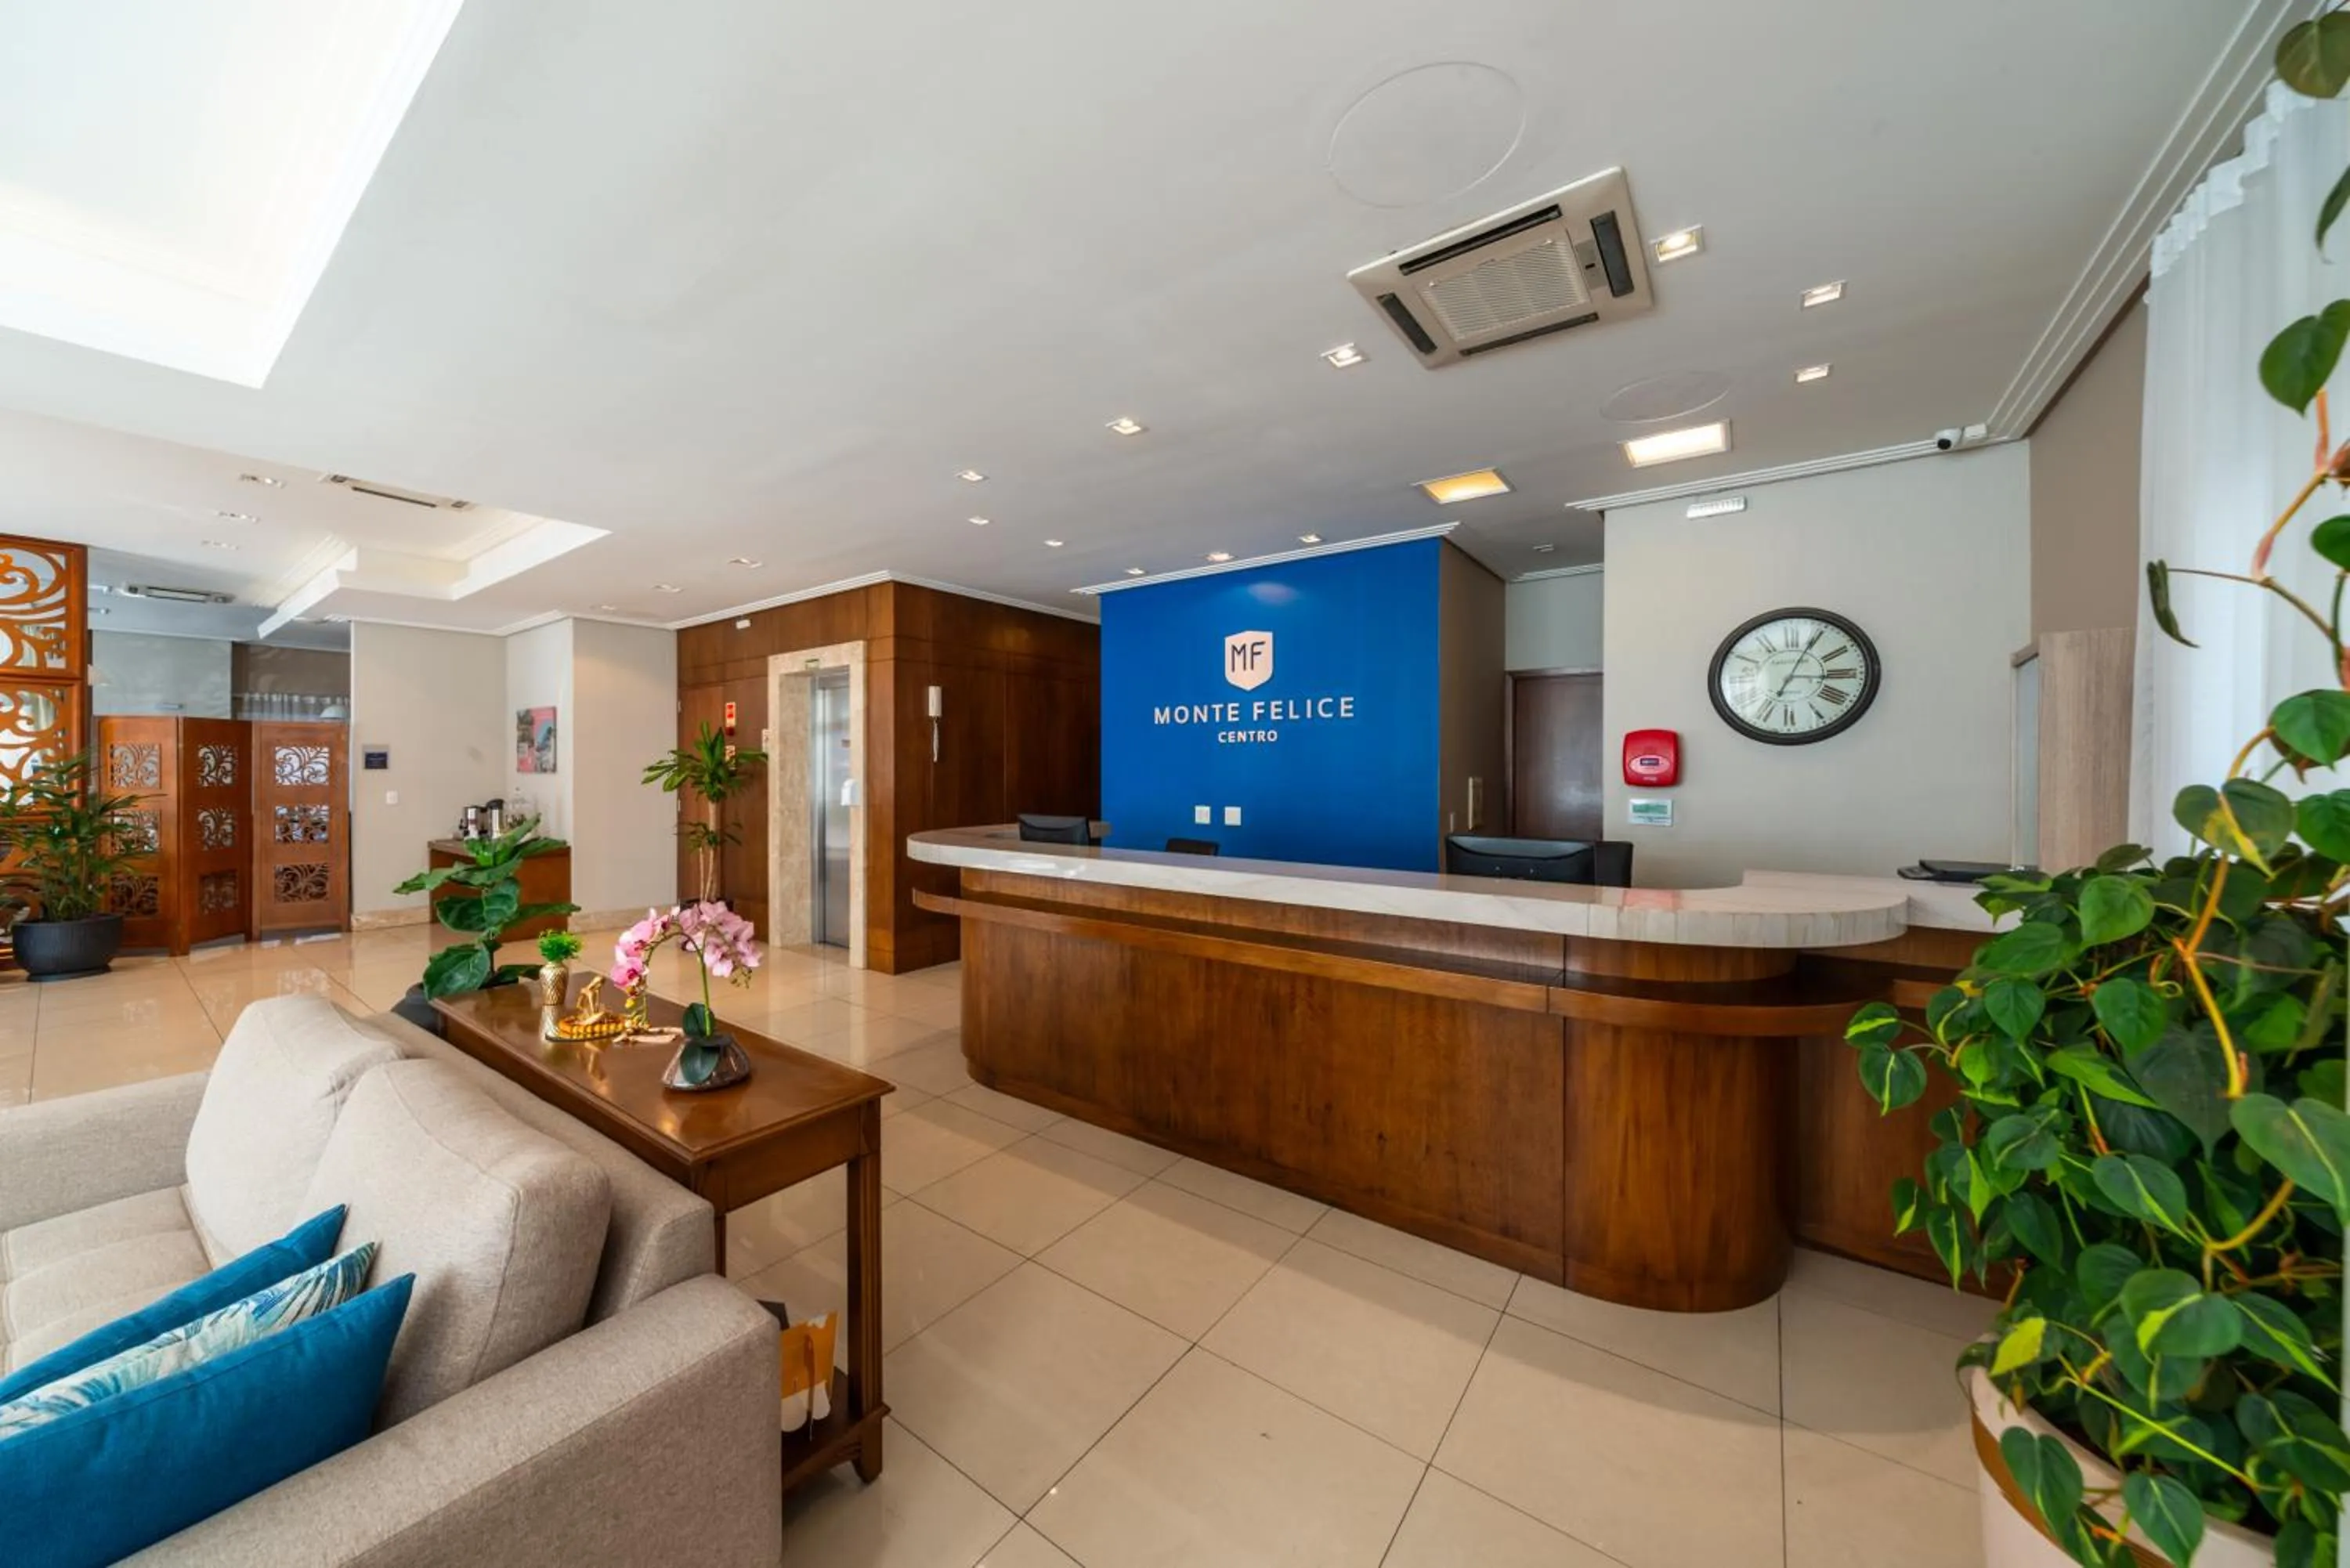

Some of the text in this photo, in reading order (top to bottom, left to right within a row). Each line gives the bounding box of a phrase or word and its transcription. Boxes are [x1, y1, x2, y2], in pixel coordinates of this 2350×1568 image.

[1231, 641, 1266, 672] MF
[1154, 696, 1354, 724] MONTE FELICE
[1218, 730, 1278, 743] CENTRO
